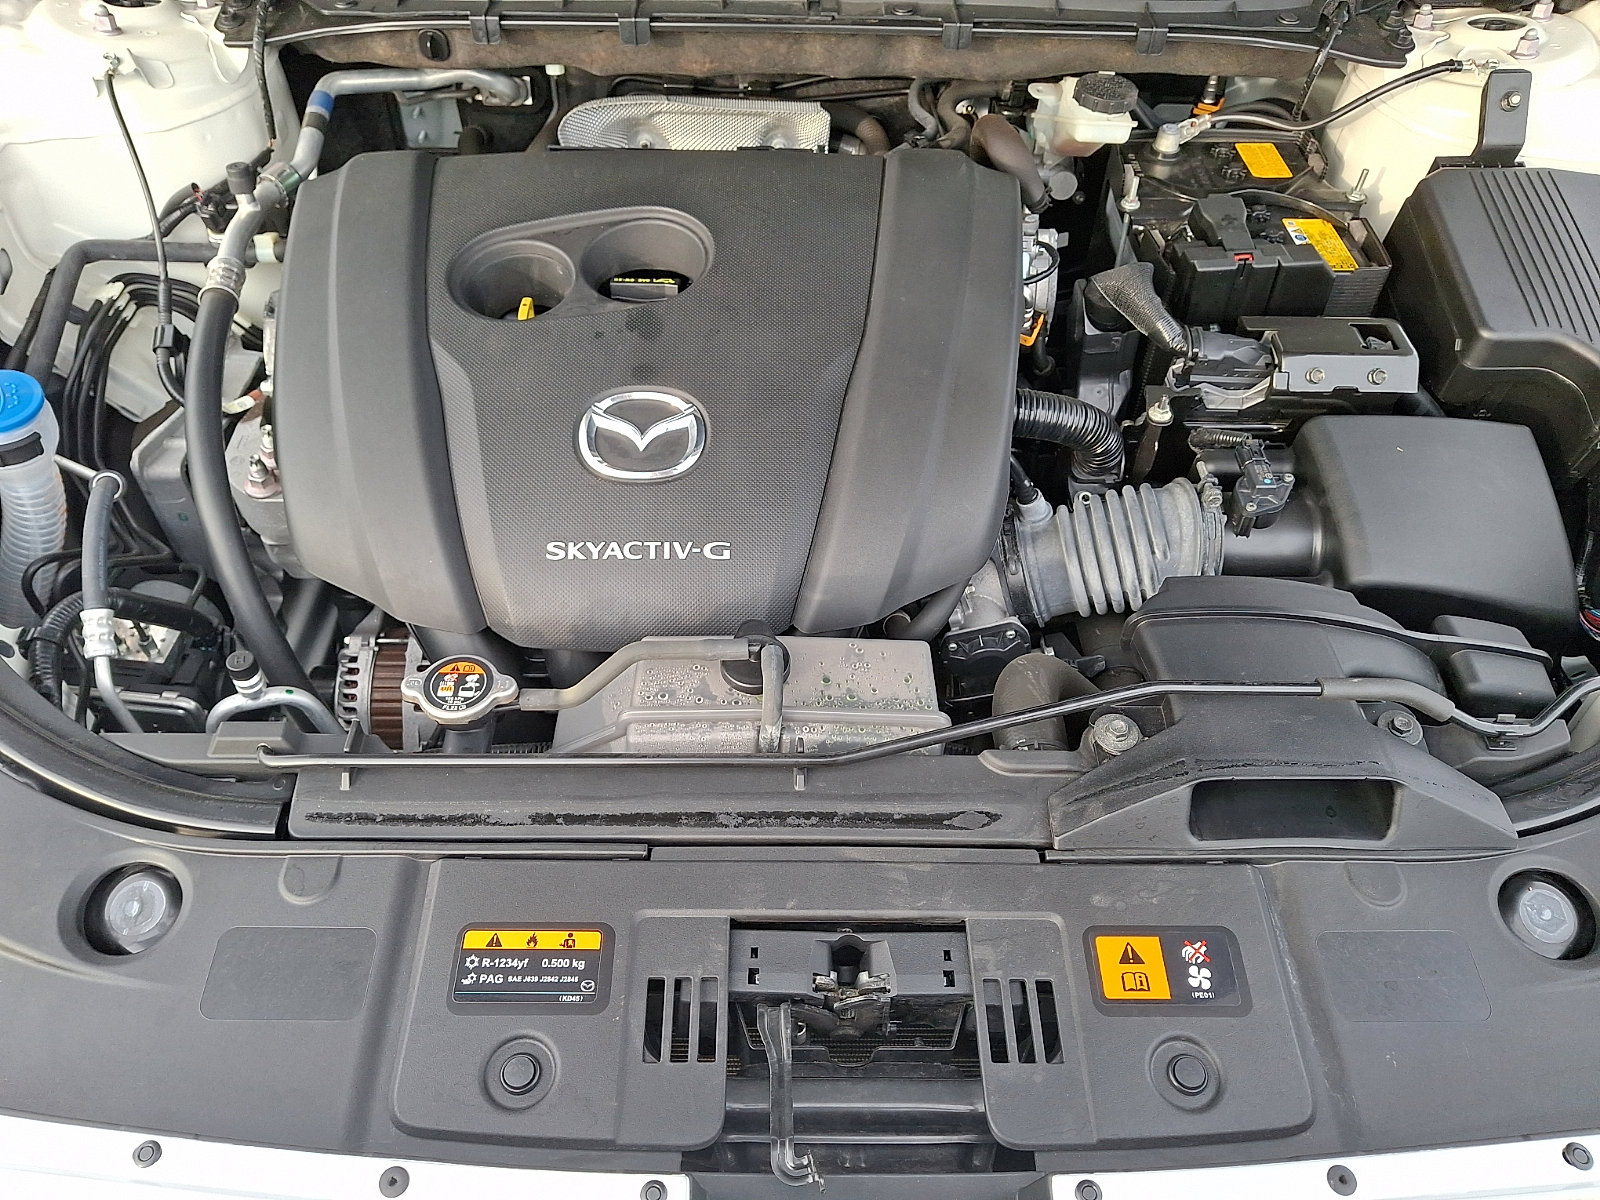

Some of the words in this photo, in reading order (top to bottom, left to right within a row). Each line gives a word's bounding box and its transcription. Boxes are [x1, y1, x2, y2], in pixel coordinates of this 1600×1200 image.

[545, 541, 731, 561] SKYACTIV-G
[481, 957, 530, 970] R-1234yf
[541, 958, 570, 968] 0.500
[572, 958, 585, 970] kg
[479, 973, 504, 984] PAG
